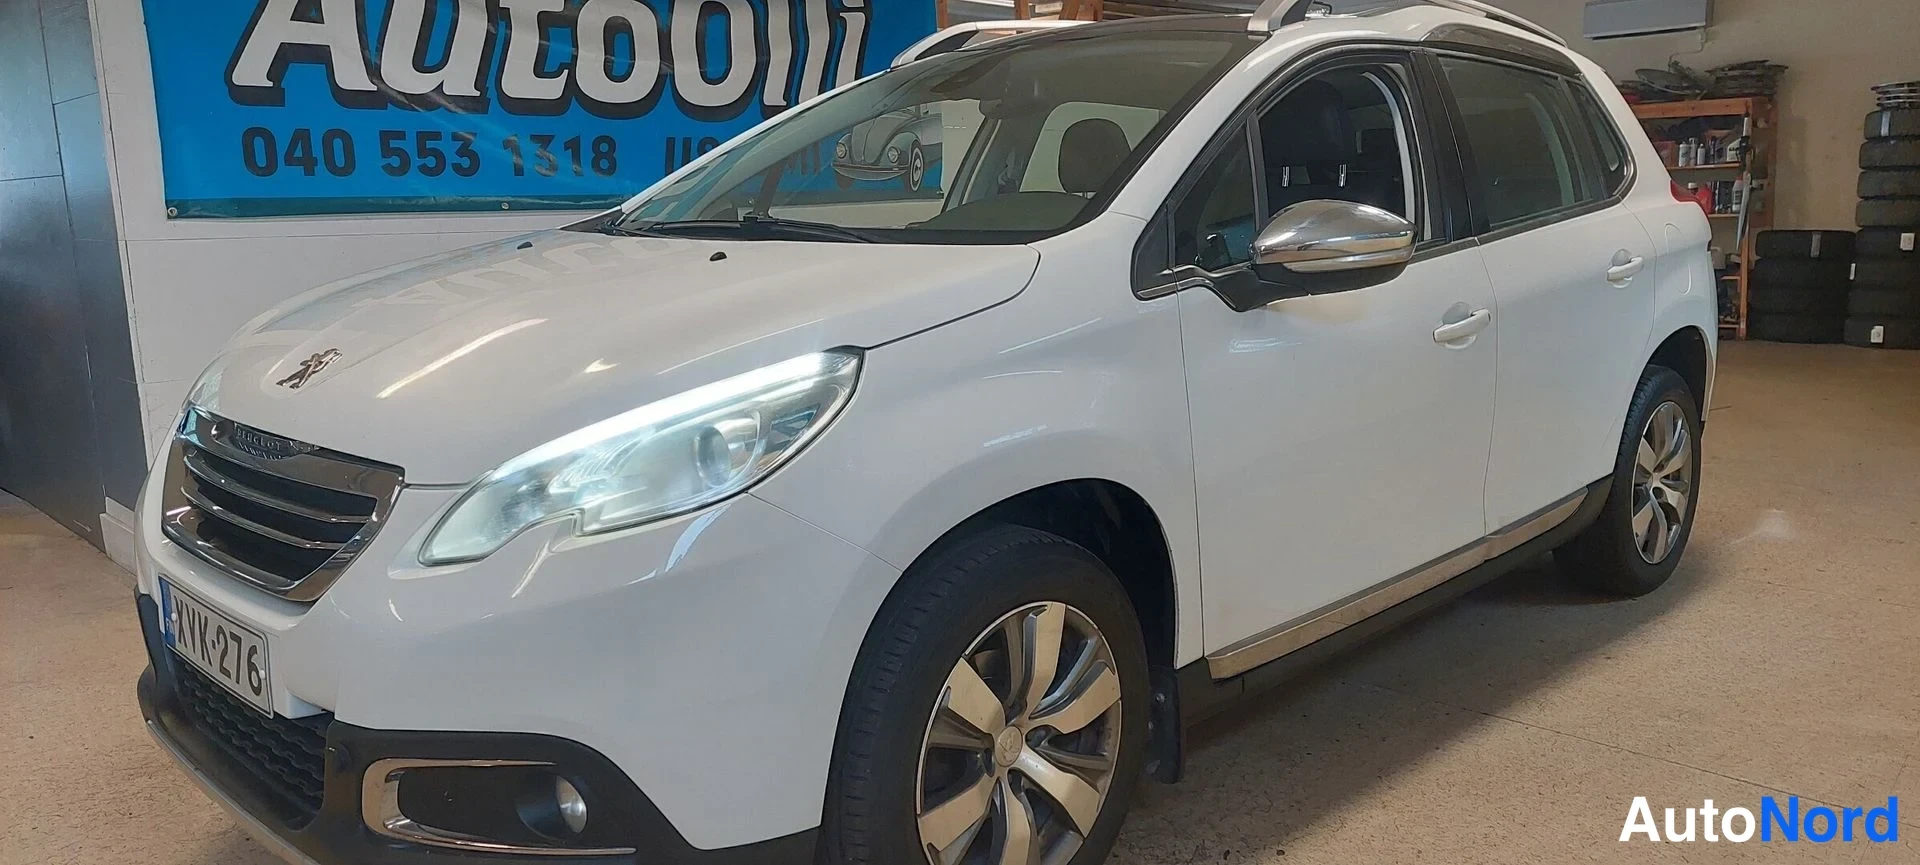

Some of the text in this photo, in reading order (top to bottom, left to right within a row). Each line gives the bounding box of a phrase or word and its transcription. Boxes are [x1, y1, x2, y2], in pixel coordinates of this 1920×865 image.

[242, 127, 617, 177] 040 553 1318
[174, 595, 263, 697] XVK-276
